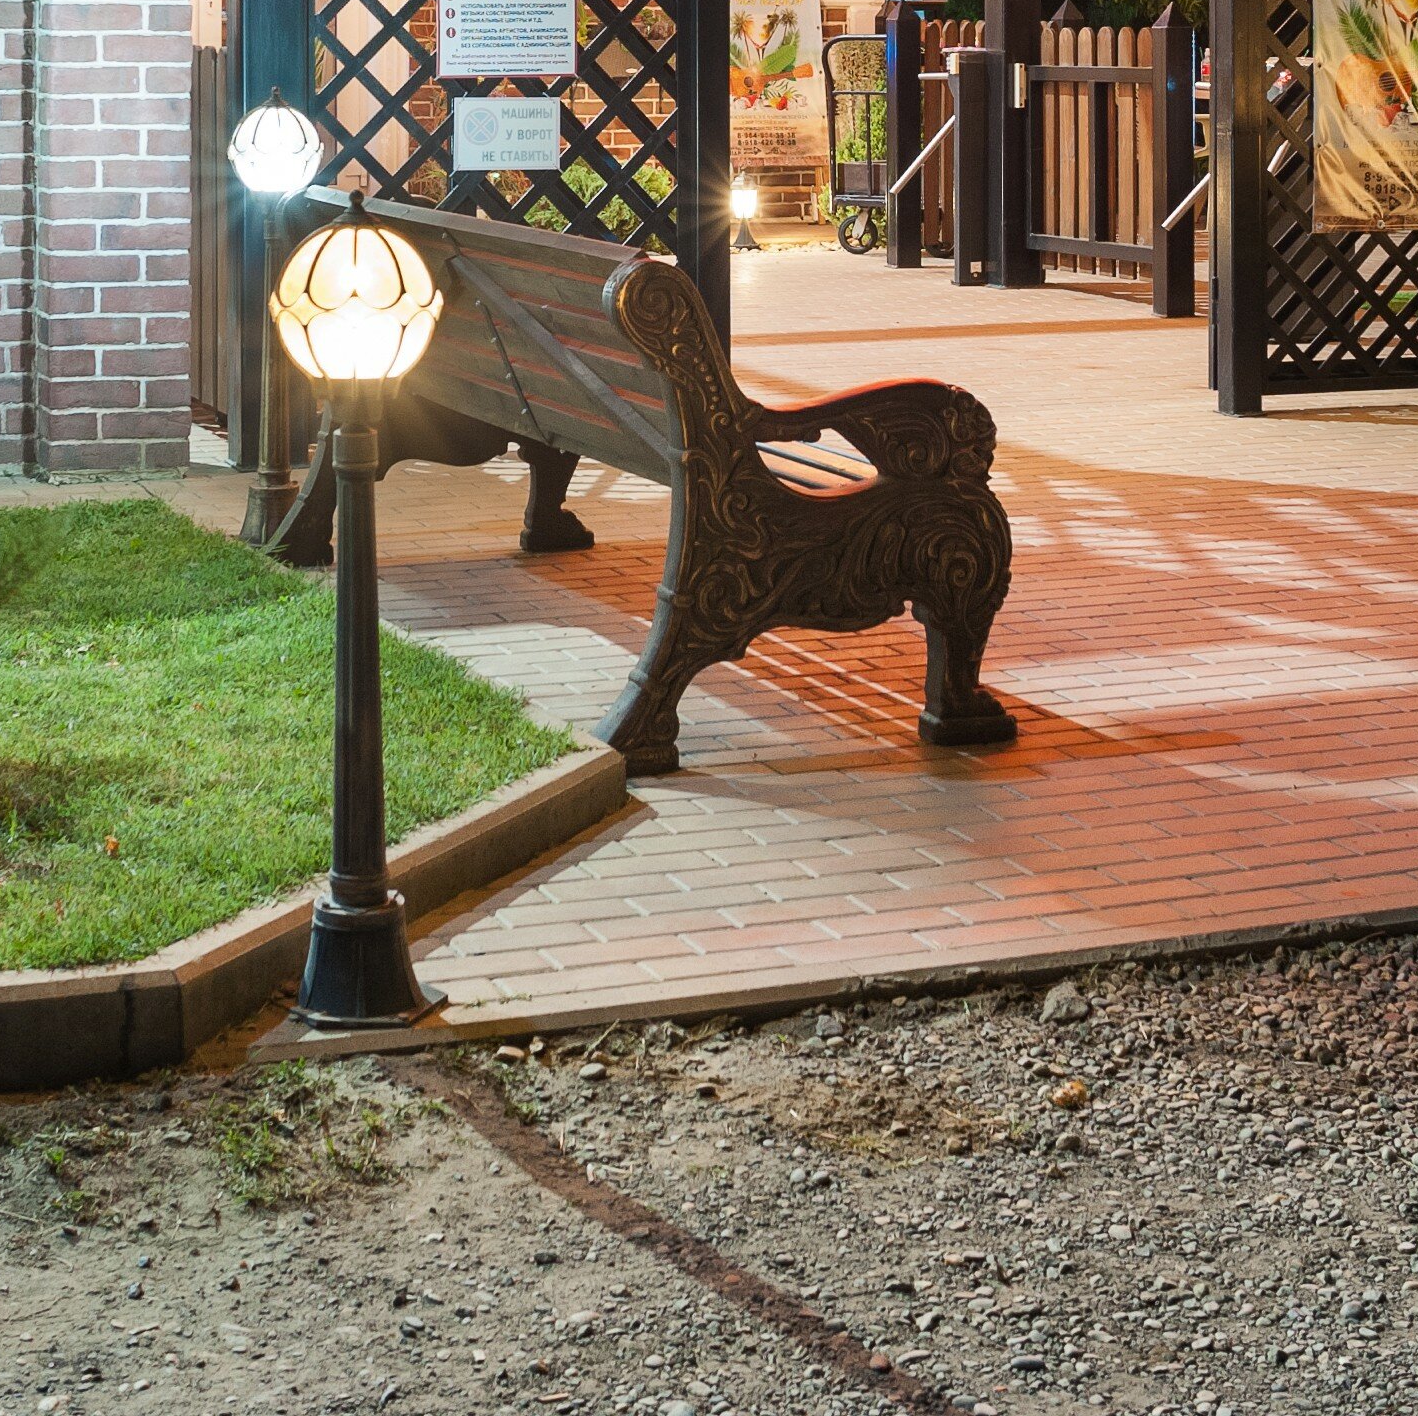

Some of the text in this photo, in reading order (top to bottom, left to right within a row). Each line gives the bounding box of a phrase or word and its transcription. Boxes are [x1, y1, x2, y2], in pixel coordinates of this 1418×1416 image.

[501, 108, 553, 119] МАШИНЫ
[506, 129, 553, 140] У ВОРОТ
[482, 150, 553, 162] НЕ СТАВИТЬ!
